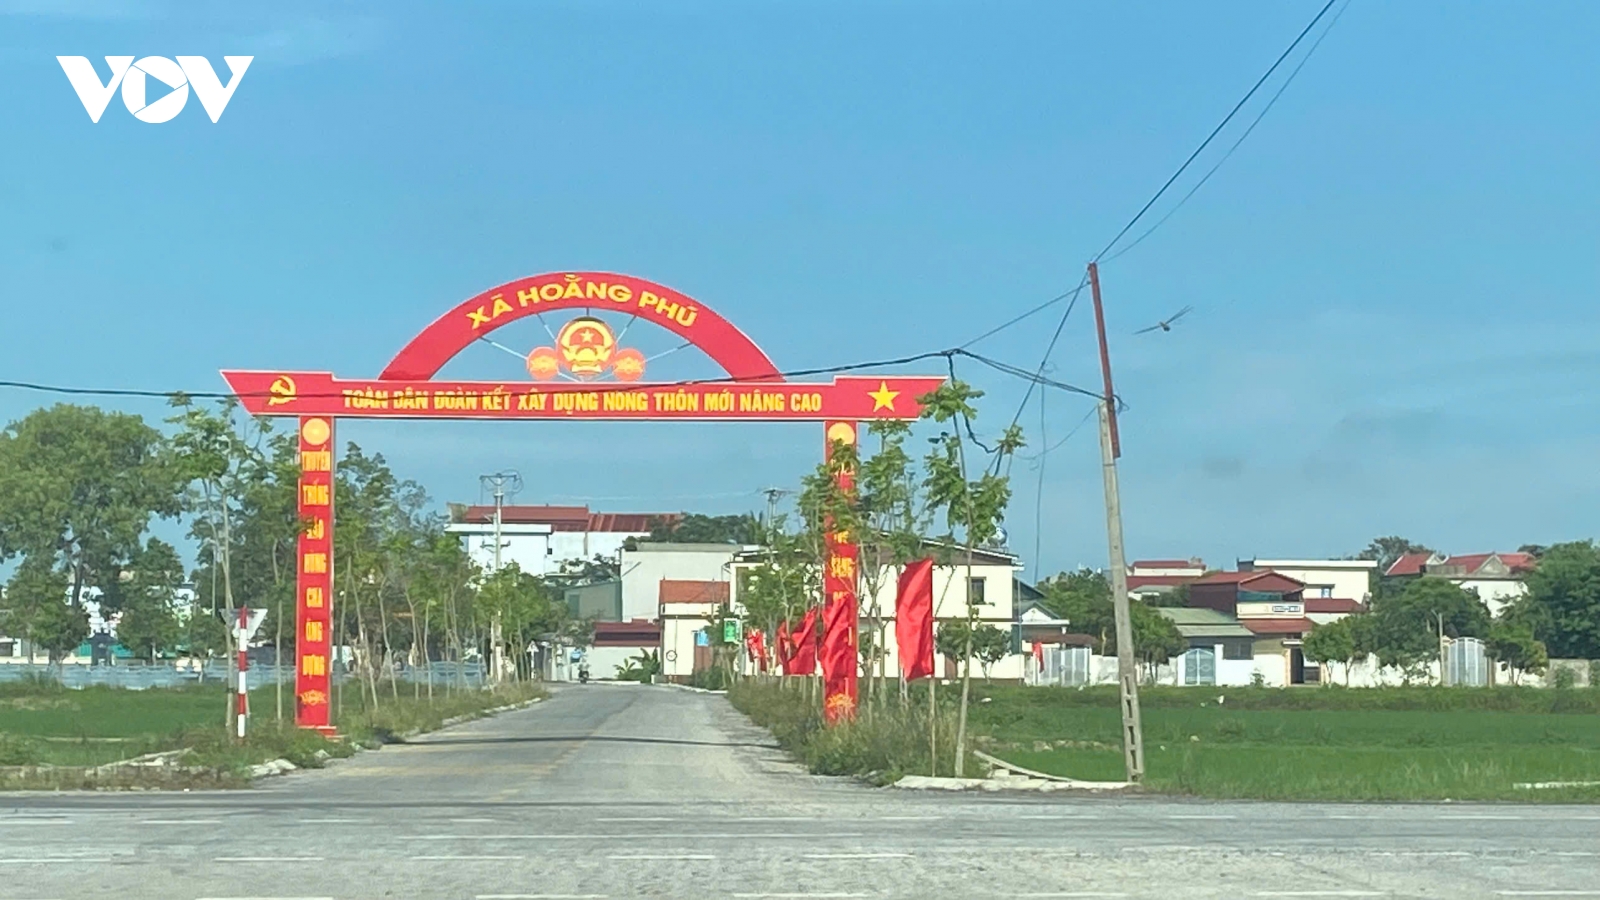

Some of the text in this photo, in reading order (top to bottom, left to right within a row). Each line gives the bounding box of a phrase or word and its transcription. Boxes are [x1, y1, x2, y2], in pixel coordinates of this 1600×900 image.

[466, 294, 514, 330] XÃ
[638, 291, 698, 327] PHÚ
[342, 386, 388, 409] TOÀN
[393, 386, 428, 410] DÂN
[434, 386, 477, 410] ĐOÀN
[482, 385, 511, 410] KẾT
[517, 387, 548, 411] XÂY
[653, 388, 699, 412] THÔN
[703, 388, 735, 412] MỚI
[739, 388, 785, 412] NÂNG
[790, 393, 822, 412] CAO
